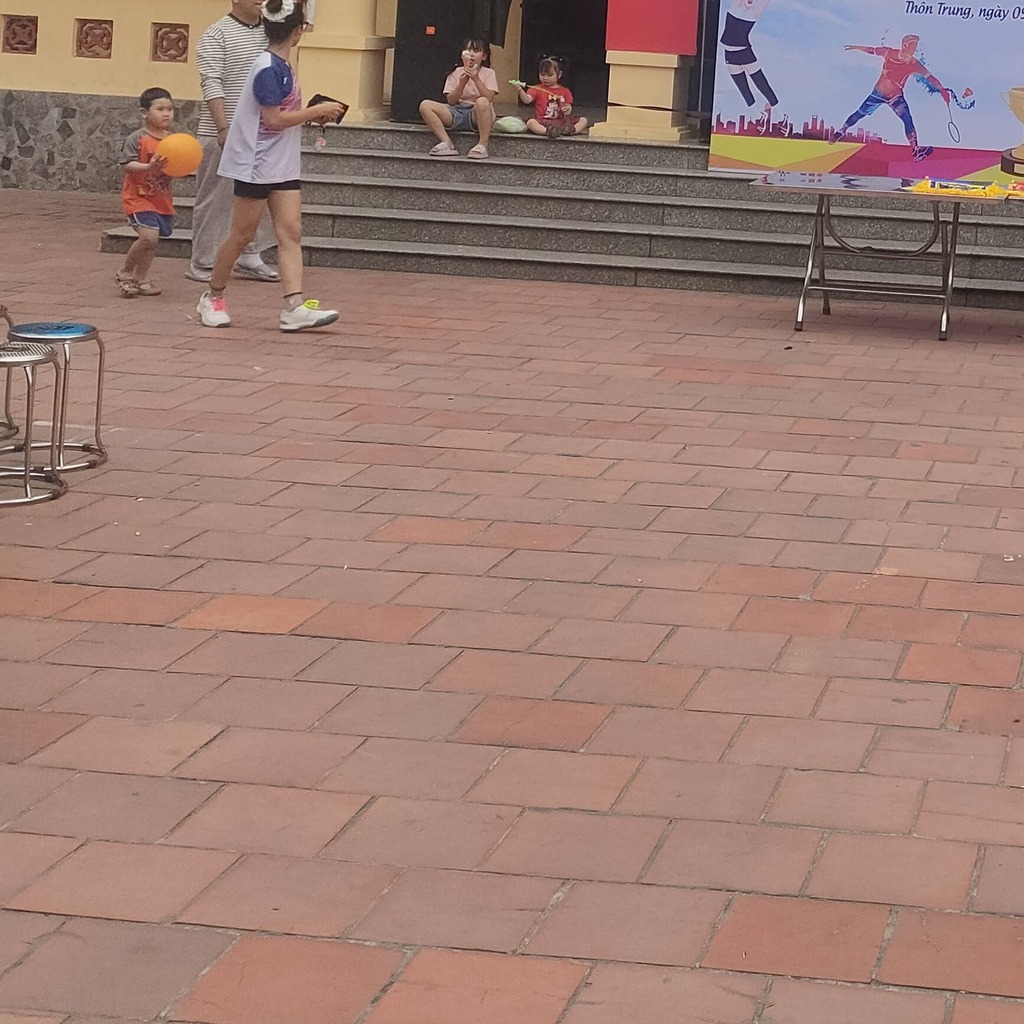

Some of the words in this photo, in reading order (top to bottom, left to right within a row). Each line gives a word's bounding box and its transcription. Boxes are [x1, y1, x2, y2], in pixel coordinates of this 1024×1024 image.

[905, 0, 934, 15] Thôn
[937, 2, 975, 19] Trung,
[978, 5, 1009, 21] ngày
